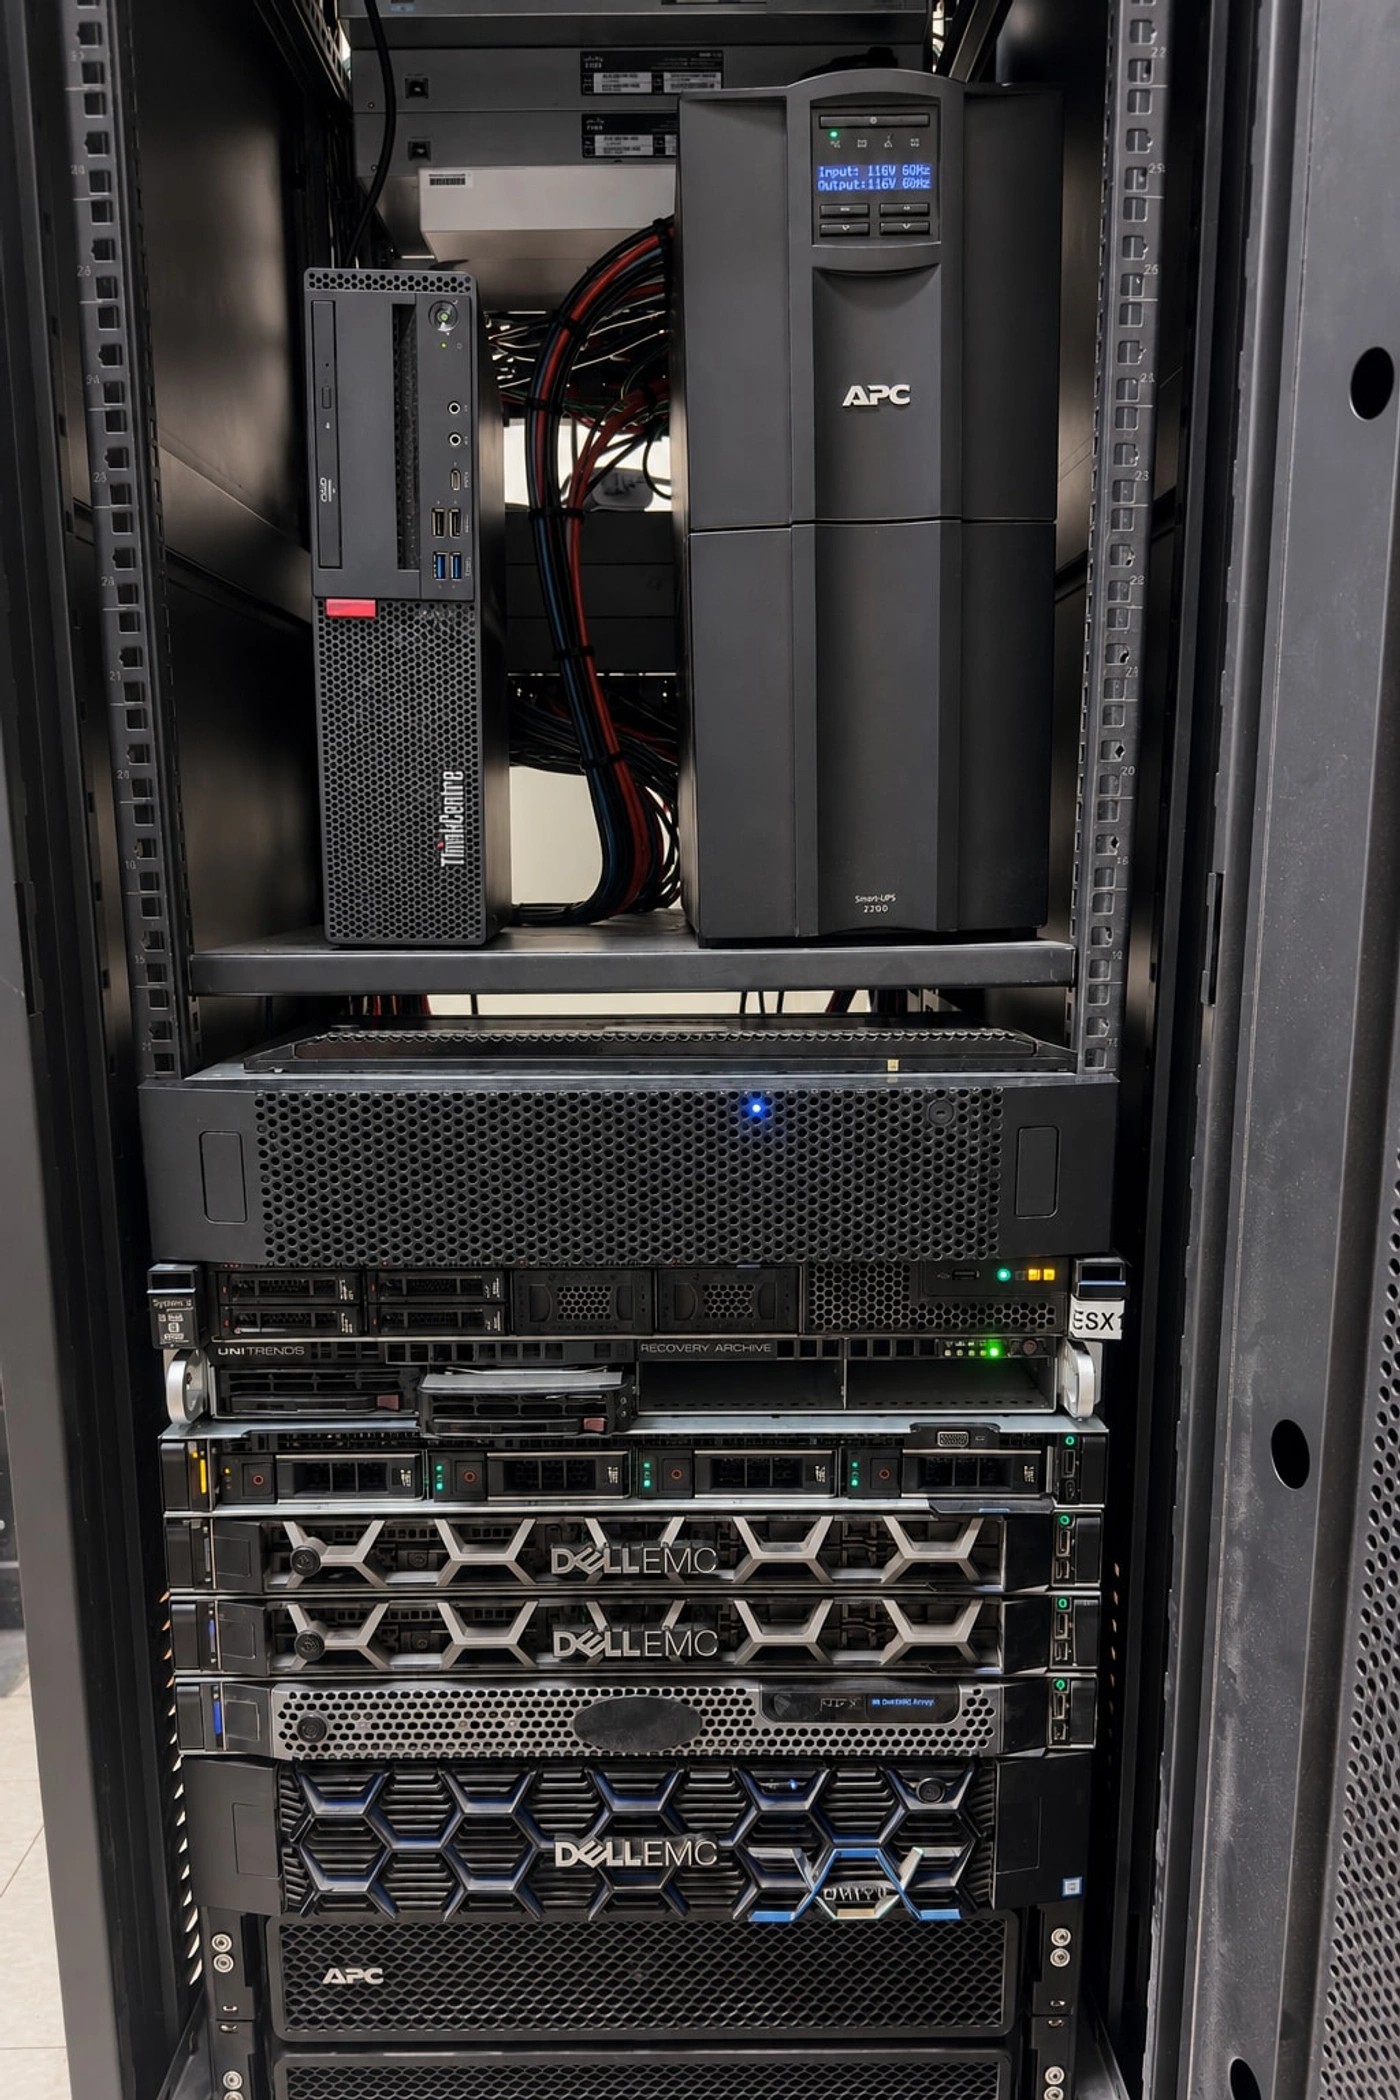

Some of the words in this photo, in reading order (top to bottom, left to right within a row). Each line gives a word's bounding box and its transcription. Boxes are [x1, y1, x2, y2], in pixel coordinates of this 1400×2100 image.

[819, 166, 859, 178] Input:
[868, 165, 896, 177] 116V
[902, 165, 931, 176] 60Hz
[842, 384, 911, 406] APC
[437, 771, 465, 868] ThinkCentre
[854, 893, 897, 904] Smart-UPS
[863, 904, 889, 913] 2200
[217, 1346, 306, 1357] UNITRENDS
[640, 1343, 710, 1354] RECOVERY
[714, 1342, 773, 1353] ARCHIVE
[322, 1967, 385, 1985] APC
